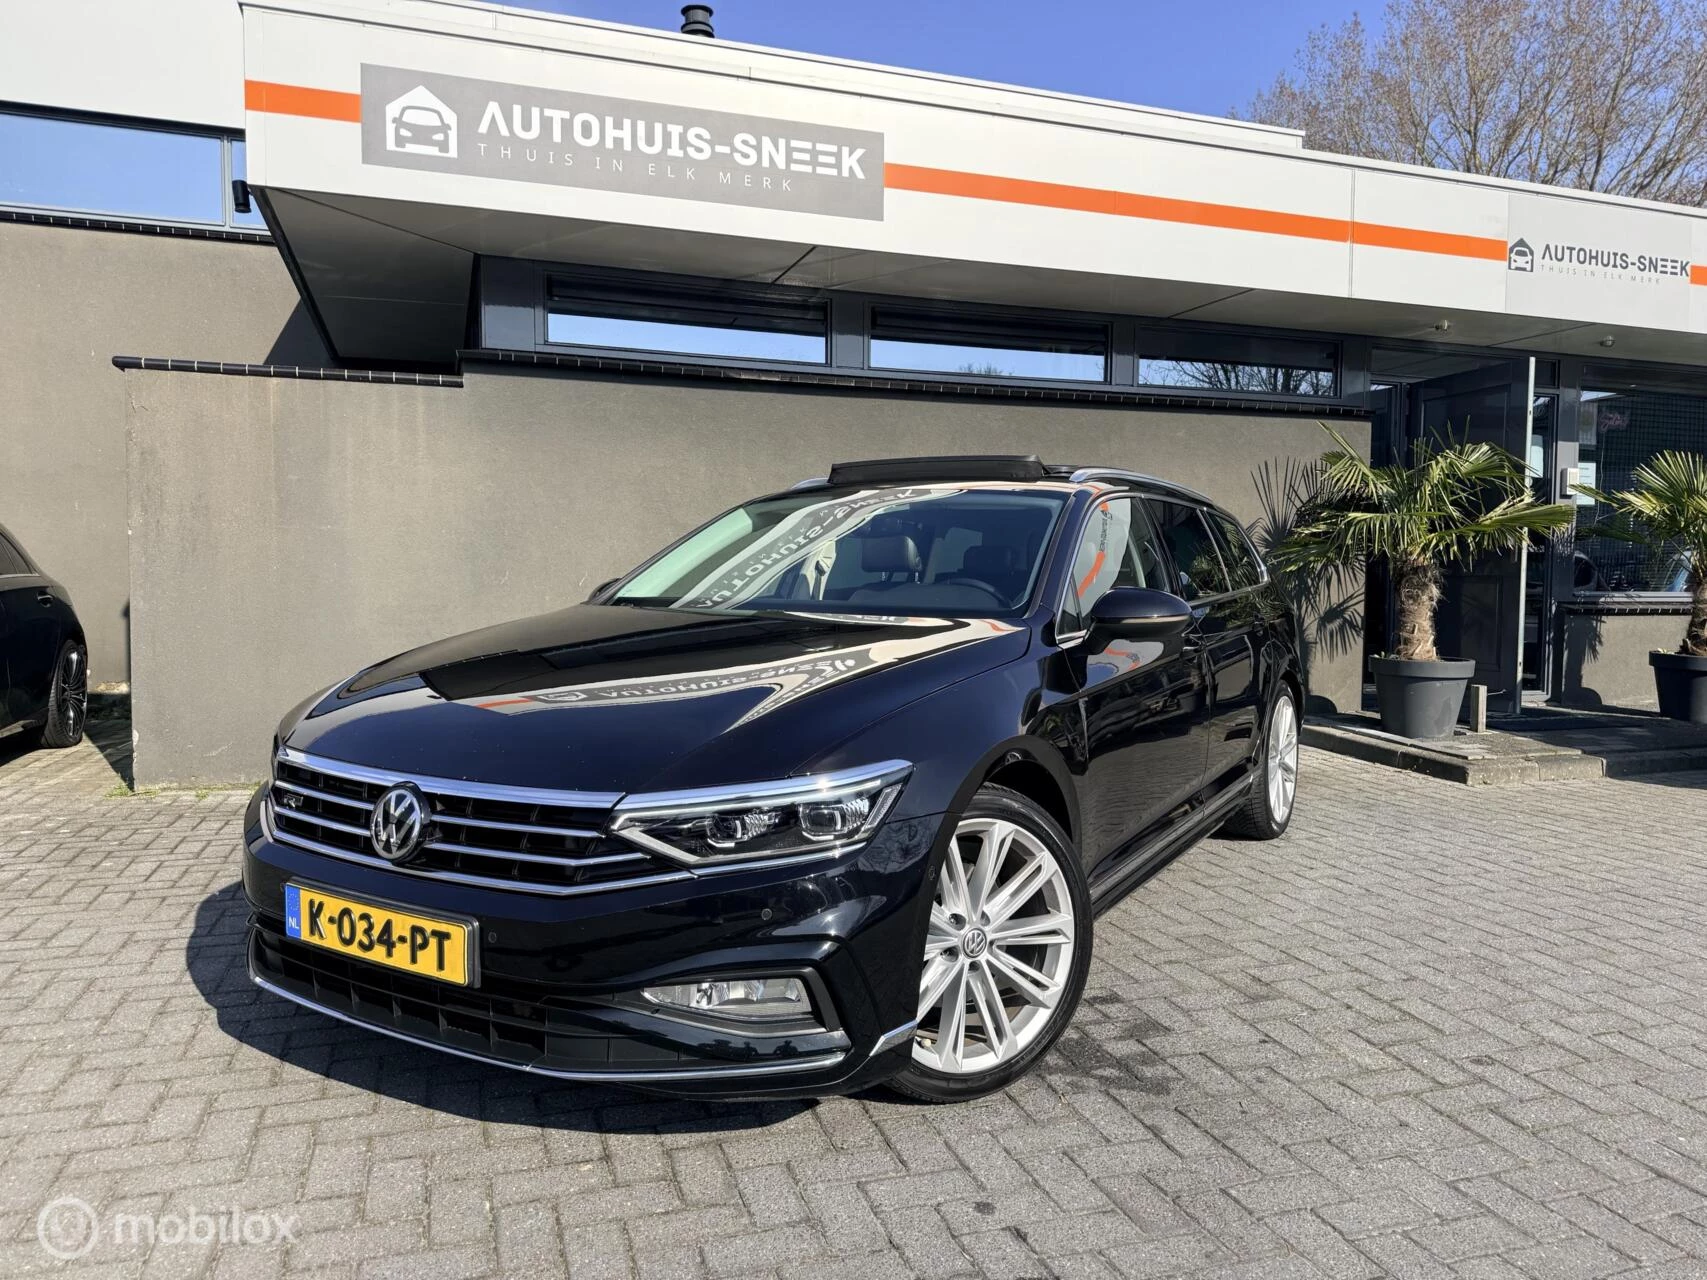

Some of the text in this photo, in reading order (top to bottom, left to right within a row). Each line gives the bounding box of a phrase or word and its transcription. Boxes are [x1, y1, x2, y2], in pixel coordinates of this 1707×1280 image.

[477, 100, 867, 180] AUTOHUIS-SNEEK
[477, 143, 791, 192] THUIS IN ELK MERK
[1541, 243, 1690, 277] AUTOHUIS-SNEEK
[288, 917, 300, 930] NL
[308, 898, 452, 972] K-034-PT
